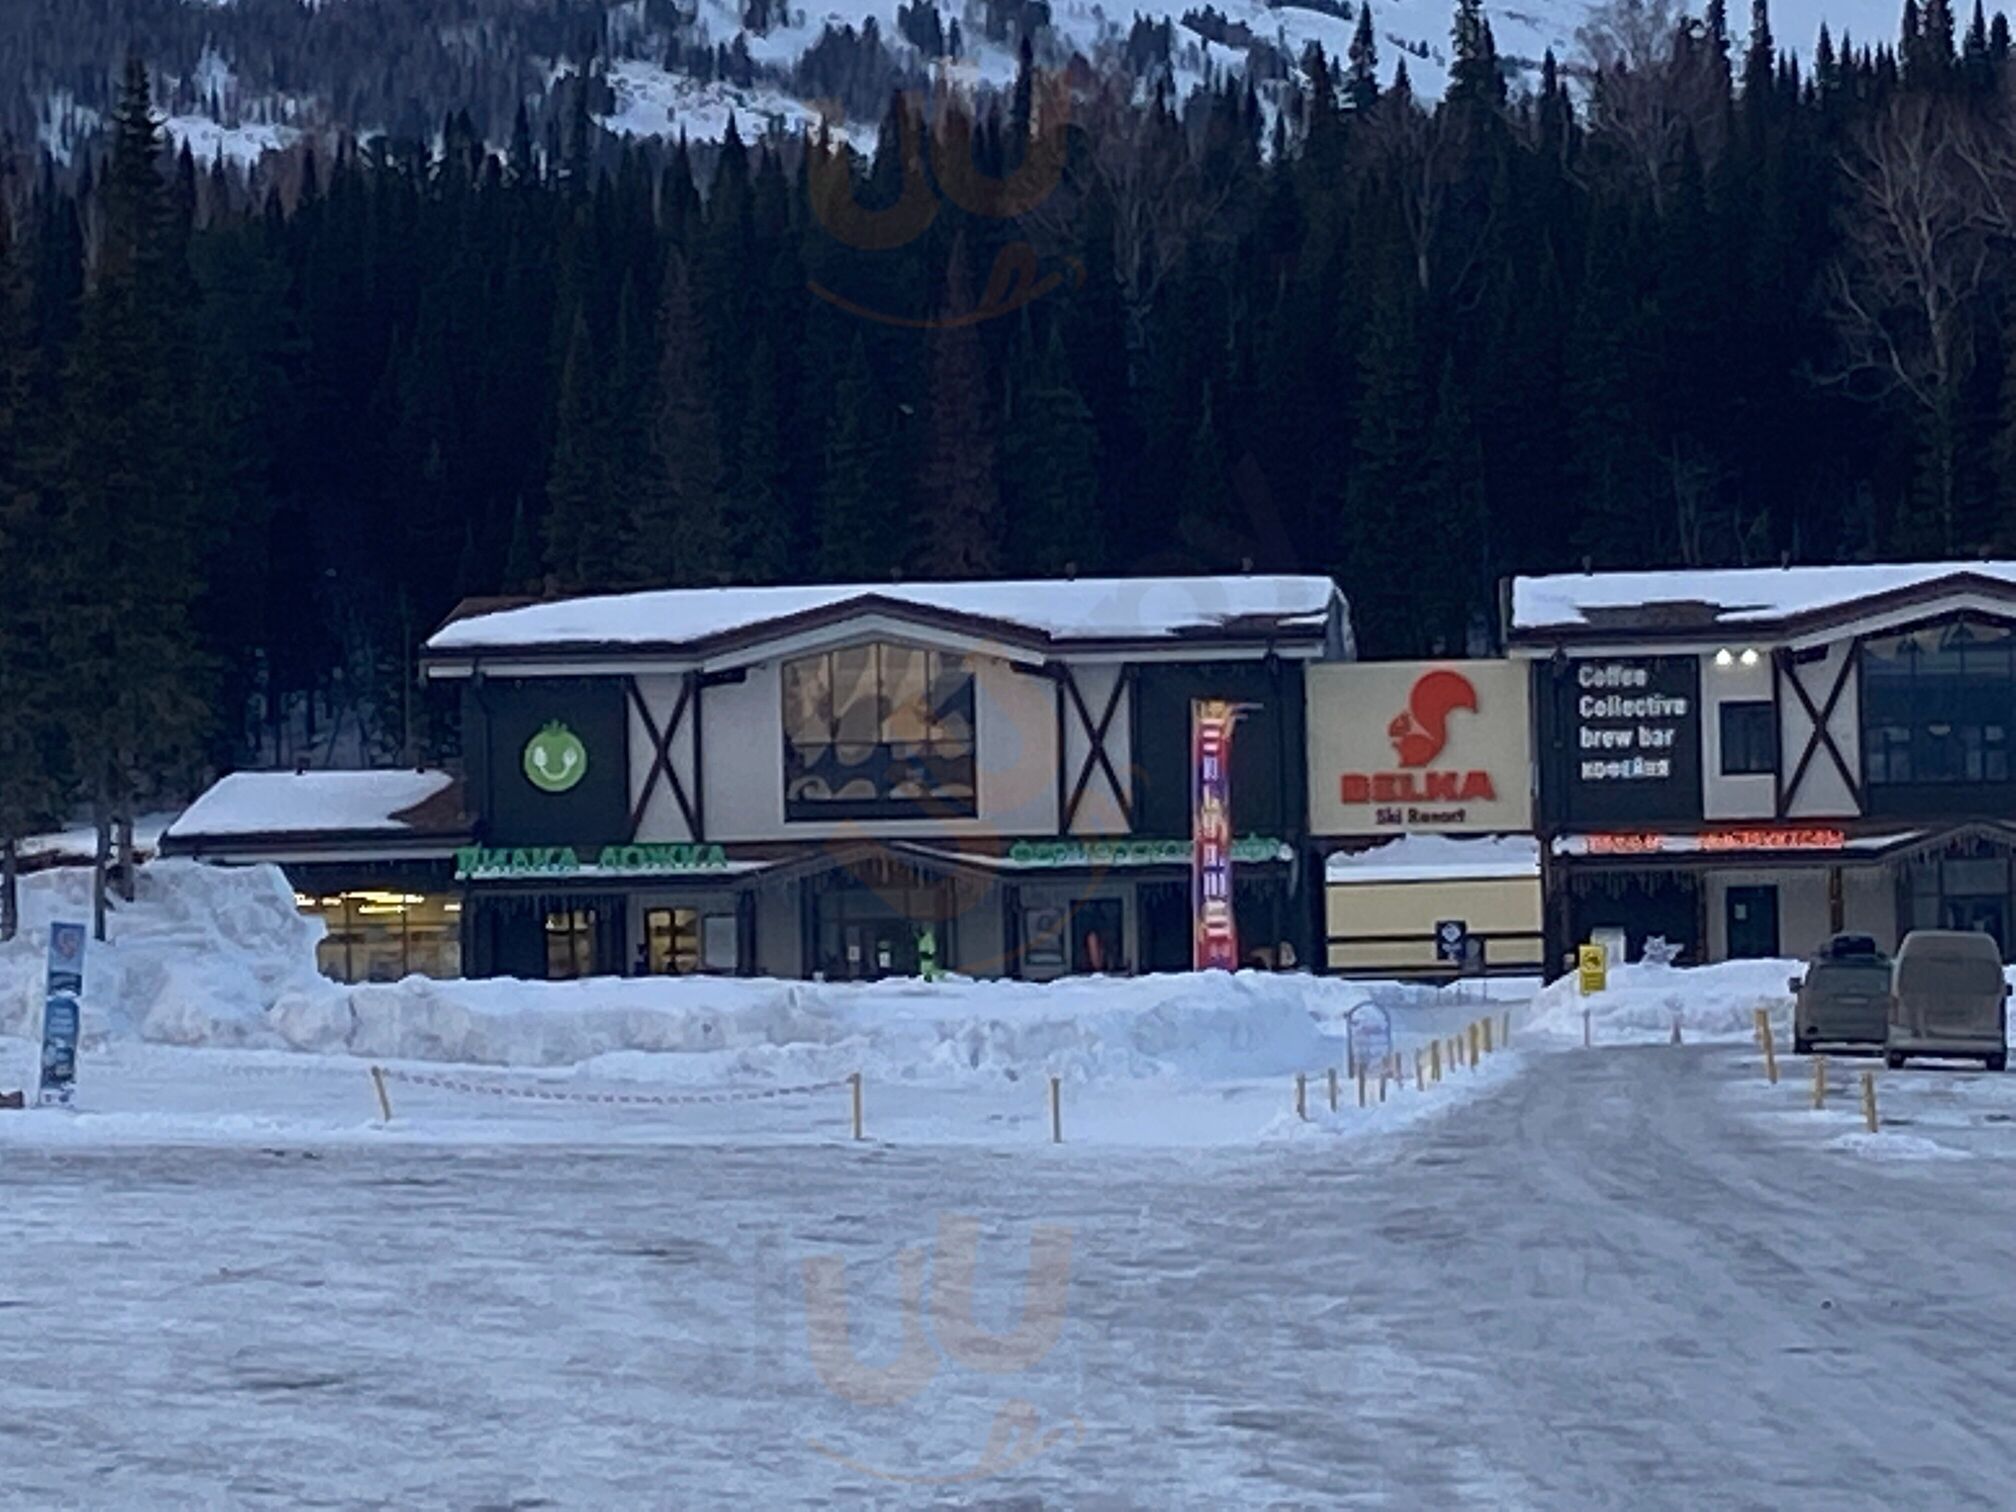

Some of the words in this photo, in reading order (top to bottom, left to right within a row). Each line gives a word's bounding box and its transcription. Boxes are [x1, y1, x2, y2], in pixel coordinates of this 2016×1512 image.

[1579, 665, 1647, 688] Coffee
[1580, 693, 1686, 718] Collective
[1580, 726, 1632, 748] brew
[1638, 726, 1675, 747] bar
[1341, 770, 1496, 804] BELKA
[1376, 807, 1402, 825] Ski
[1407, 807, 1466, 824] Resort
